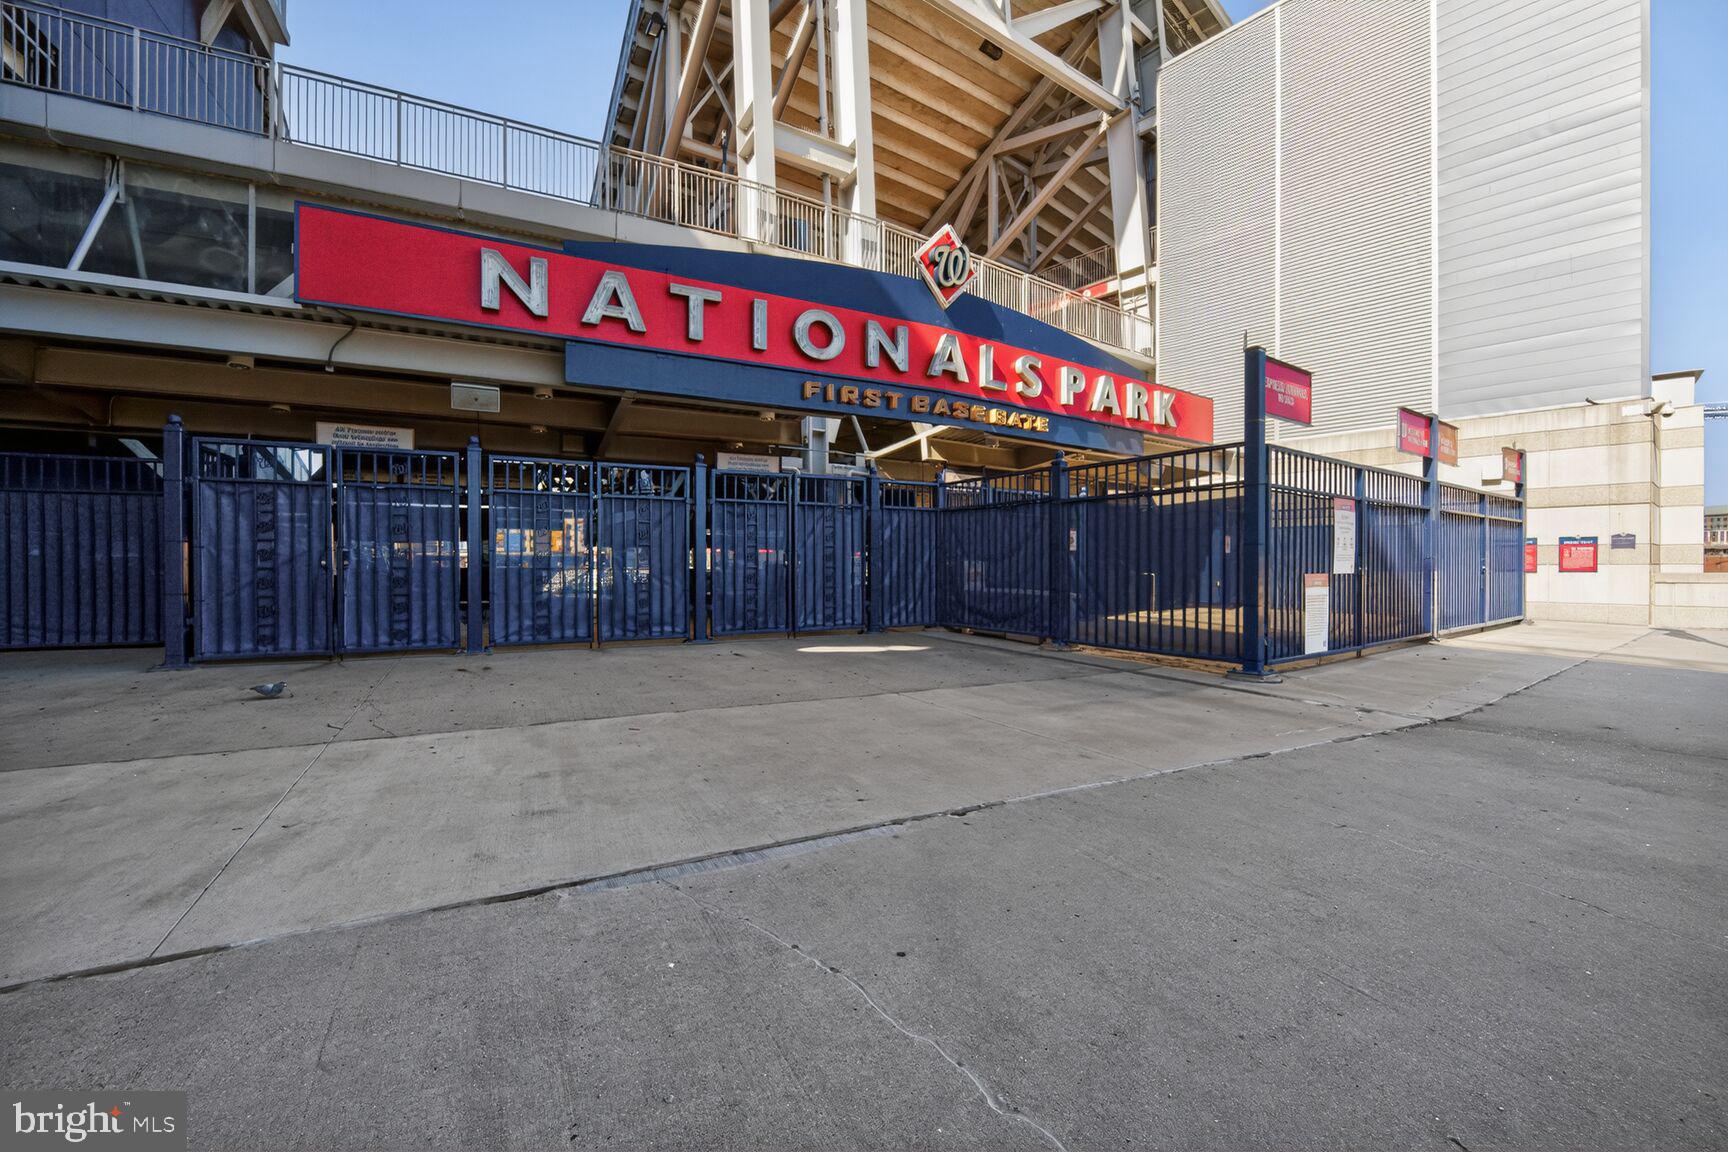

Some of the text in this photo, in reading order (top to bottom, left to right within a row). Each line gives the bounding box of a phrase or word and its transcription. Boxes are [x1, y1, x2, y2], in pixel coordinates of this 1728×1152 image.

[480, 247, 1178, 428] NATIONALS PARK
[803, 380, 904, 409] FIRST
[911, 395, 987, 422] BASE
